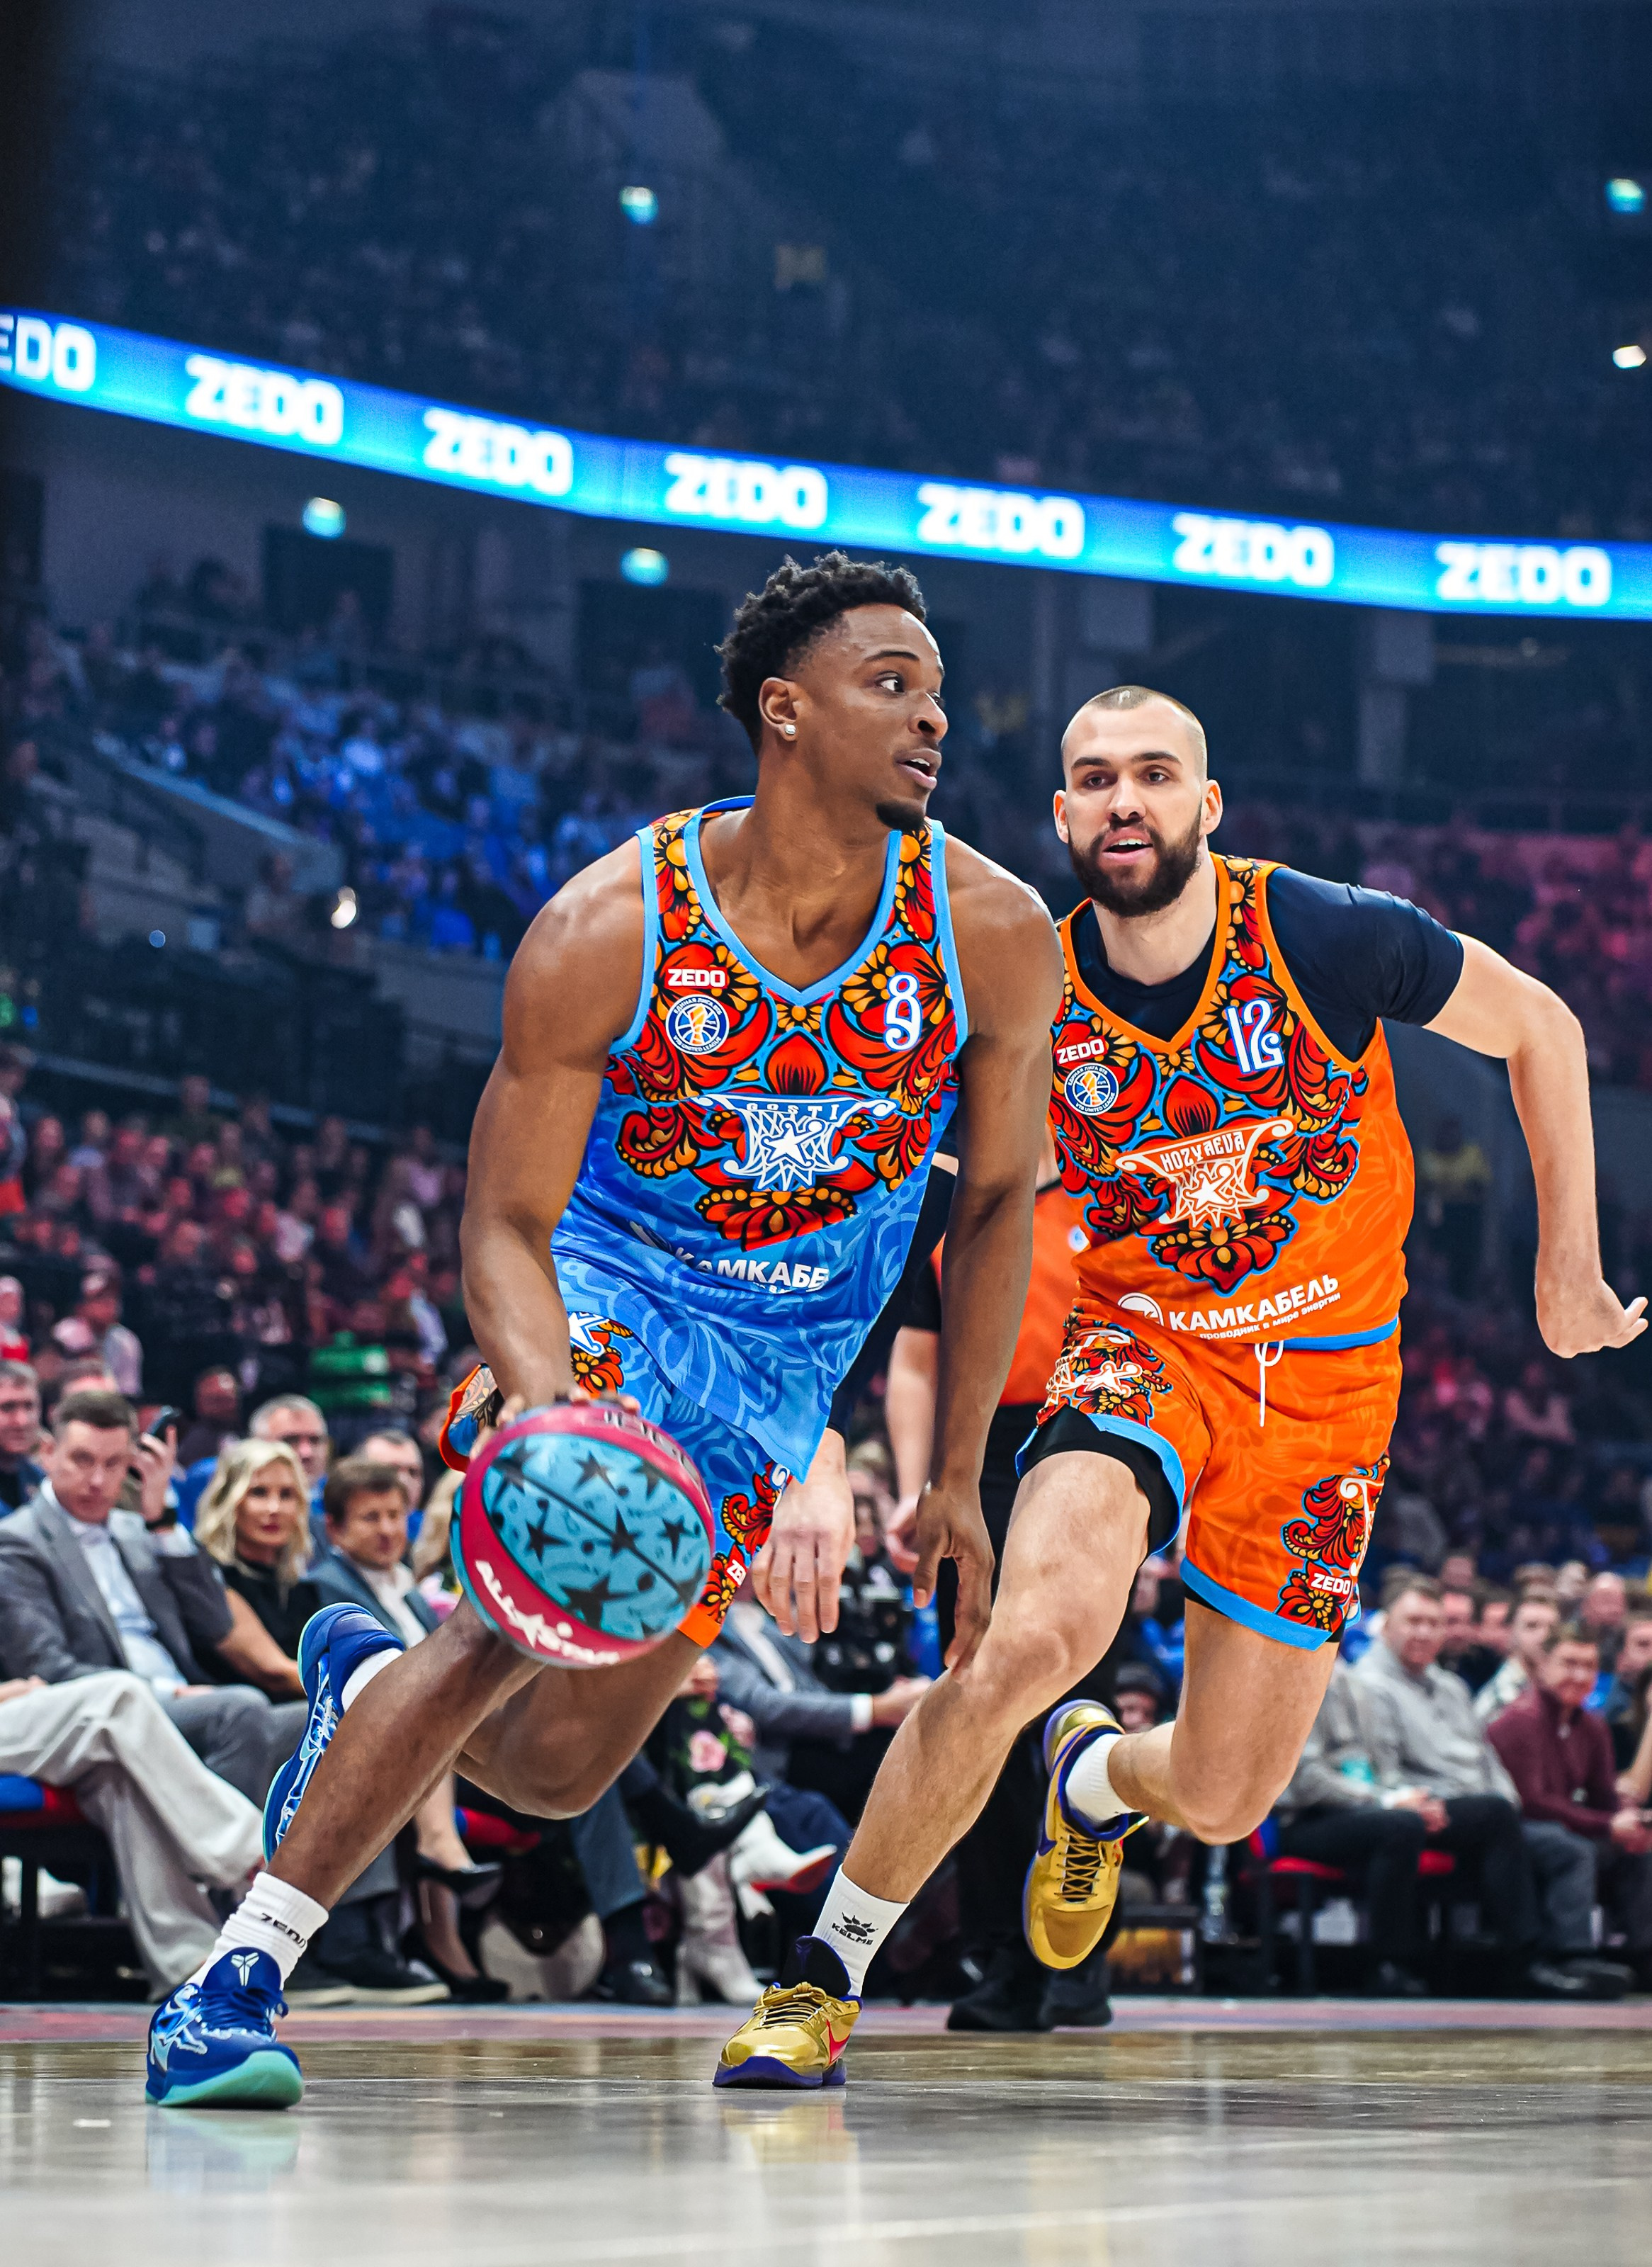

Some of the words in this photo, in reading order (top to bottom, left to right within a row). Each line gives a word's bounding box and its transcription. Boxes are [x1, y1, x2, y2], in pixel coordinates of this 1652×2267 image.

[186, 354, 344, 446] ZEDO
[424, 407, 574, 496] ZEDO
[664, 451, 828, 529] ZEDO
[917, 482, 1085, 559] ZEDO
[1173, 512, 1335, 588] ZEDO
[1436, 542, 1612, 607] ZEDO
[667, 968, 726, 988] ZEDO
[883, 971, 923, 1051] 8
[1226, 997, 1286, 1074] 12
[1056, 1038, 1106, 1065] ZEDO
[746, 1102, 839, 1120] GOSTI
[1160, 1131, 1245, 1172] HOZYAEVA
[1169, 1274, 1339, 1331] КАМКАБЕЛЬ
[1199, 1323, 1261, 1340] проводник
[1262, 1321, 1270, 1330] в
[1272, 1310, 1299, 1327] мире
[1301, 1292, 1341, 1316] энергии
[1311, 1572, 1352, 1595] ZEDO
[832, 1922, 873, 1945] KELME
